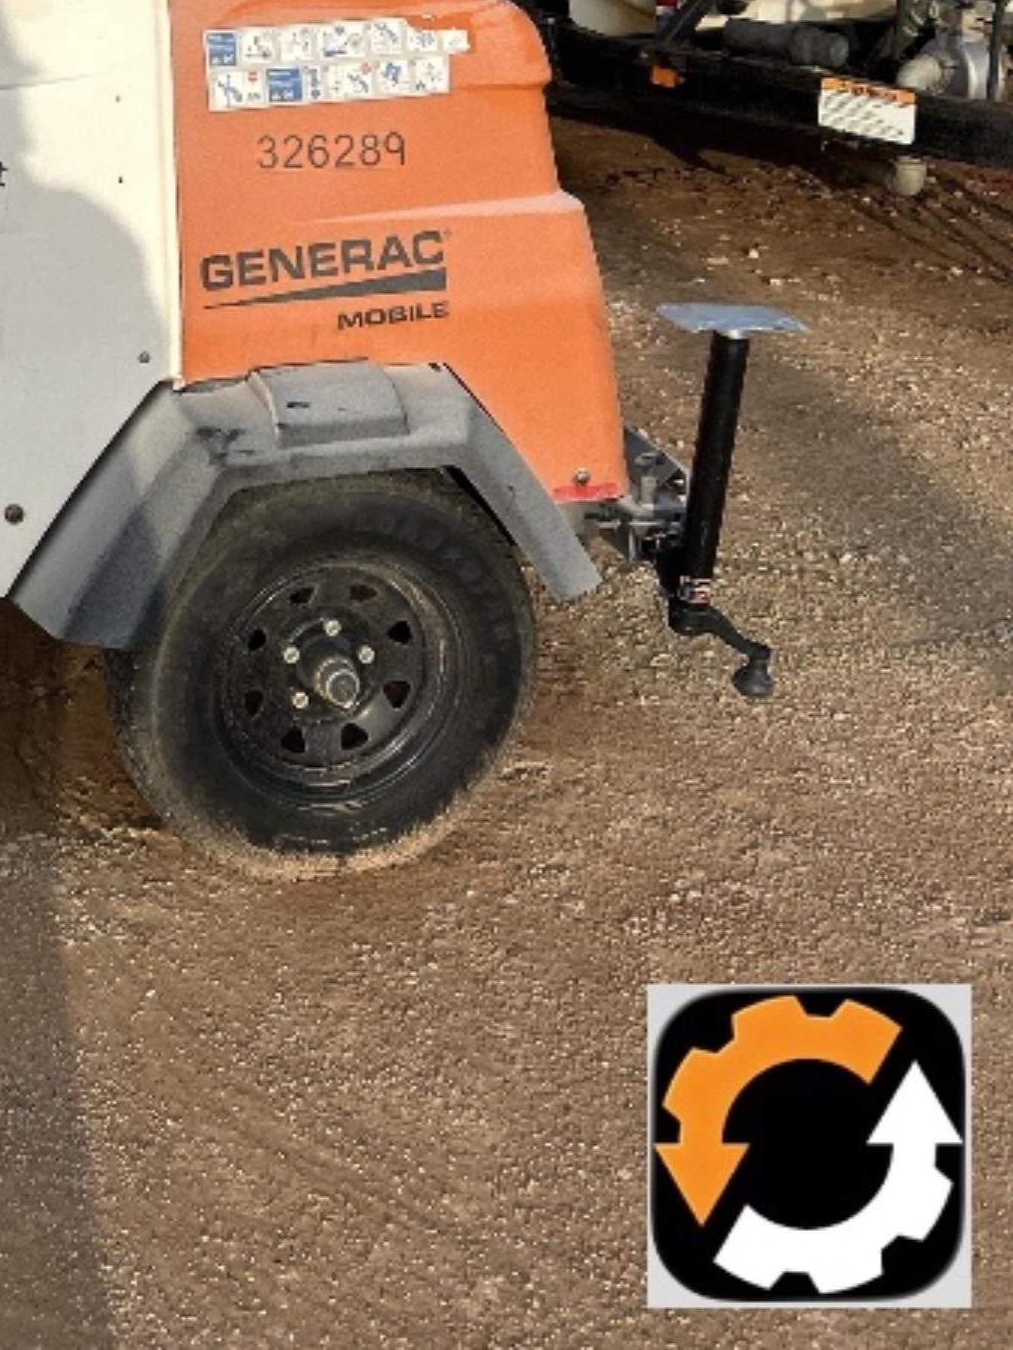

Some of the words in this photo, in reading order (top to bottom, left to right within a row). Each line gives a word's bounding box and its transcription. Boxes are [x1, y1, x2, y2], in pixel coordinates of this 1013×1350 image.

[257, 132, 406, 169] 326289
[200, 229, 445, 291] GENERAC
[337, 301, 450, 330] MOBILE
